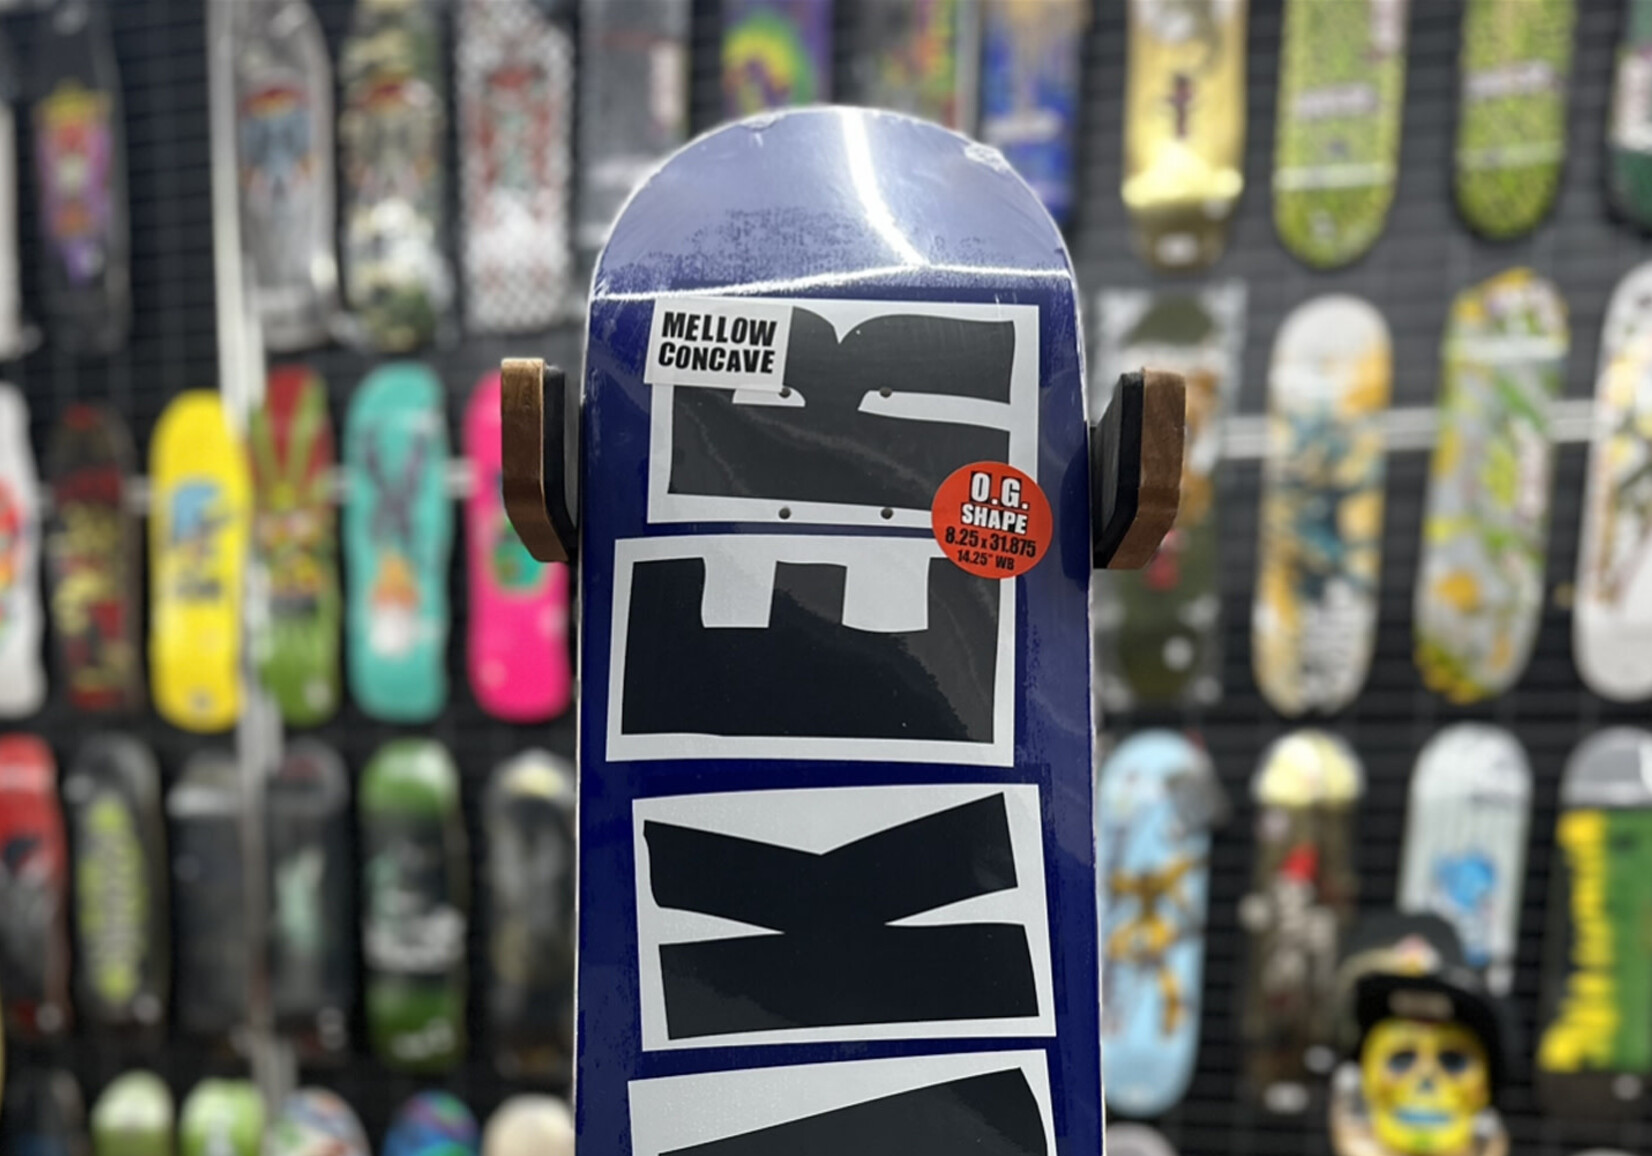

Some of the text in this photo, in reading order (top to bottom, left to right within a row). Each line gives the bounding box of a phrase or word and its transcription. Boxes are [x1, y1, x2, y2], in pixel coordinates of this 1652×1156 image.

[661, 311, 778, 347] MELLOW
[658, 341, 776, 374] CONCAVE
[970, 471, 1030, 510] O.G.
[961, 503, 1028, 535] SHAPE
[945, 525, 1036, 558] 8.25 x 31.875
[995, 554, 1016, 571] WB
